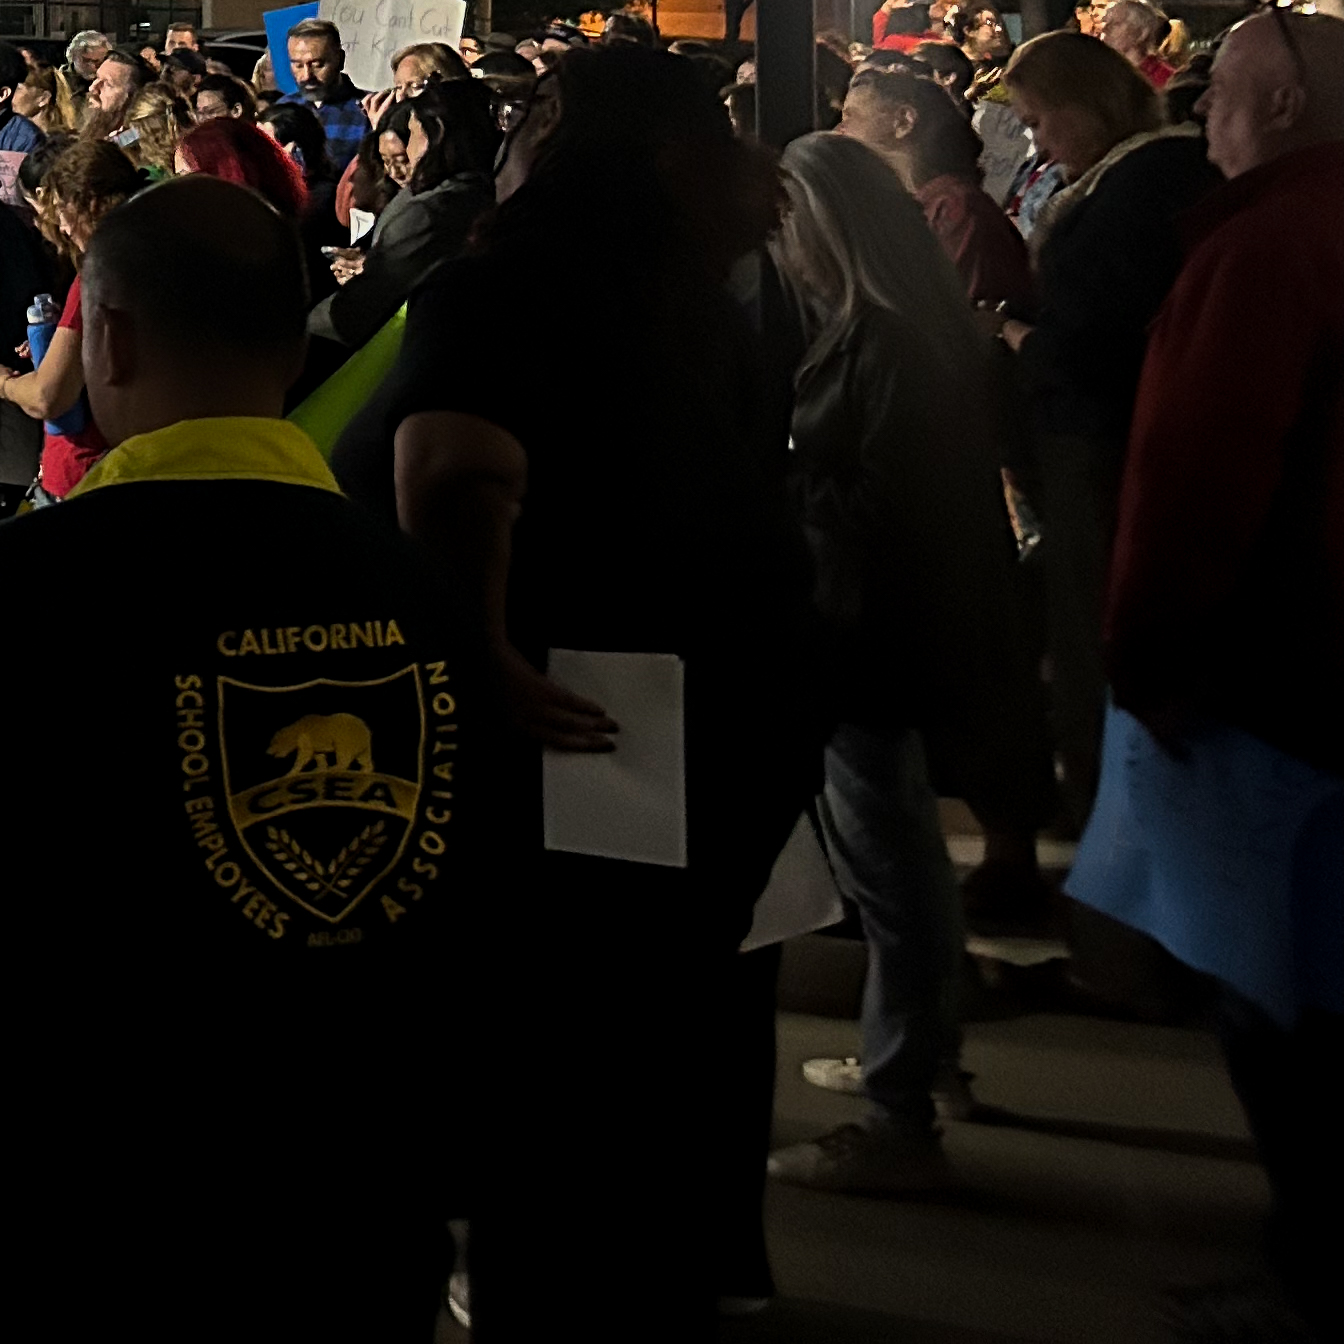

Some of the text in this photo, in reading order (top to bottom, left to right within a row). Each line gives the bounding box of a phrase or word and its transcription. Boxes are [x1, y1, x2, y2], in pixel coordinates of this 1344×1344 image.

[216, 619, 406, 658] CALIFORNIA
[174, 673, 291, 940] SCHOOL EMPLOYEES
[248, 775, 400, 816] CSEA
[378, 660, 460, 923] ASSOCIATION
[306, 926, 363, 948] AFL-CIO
